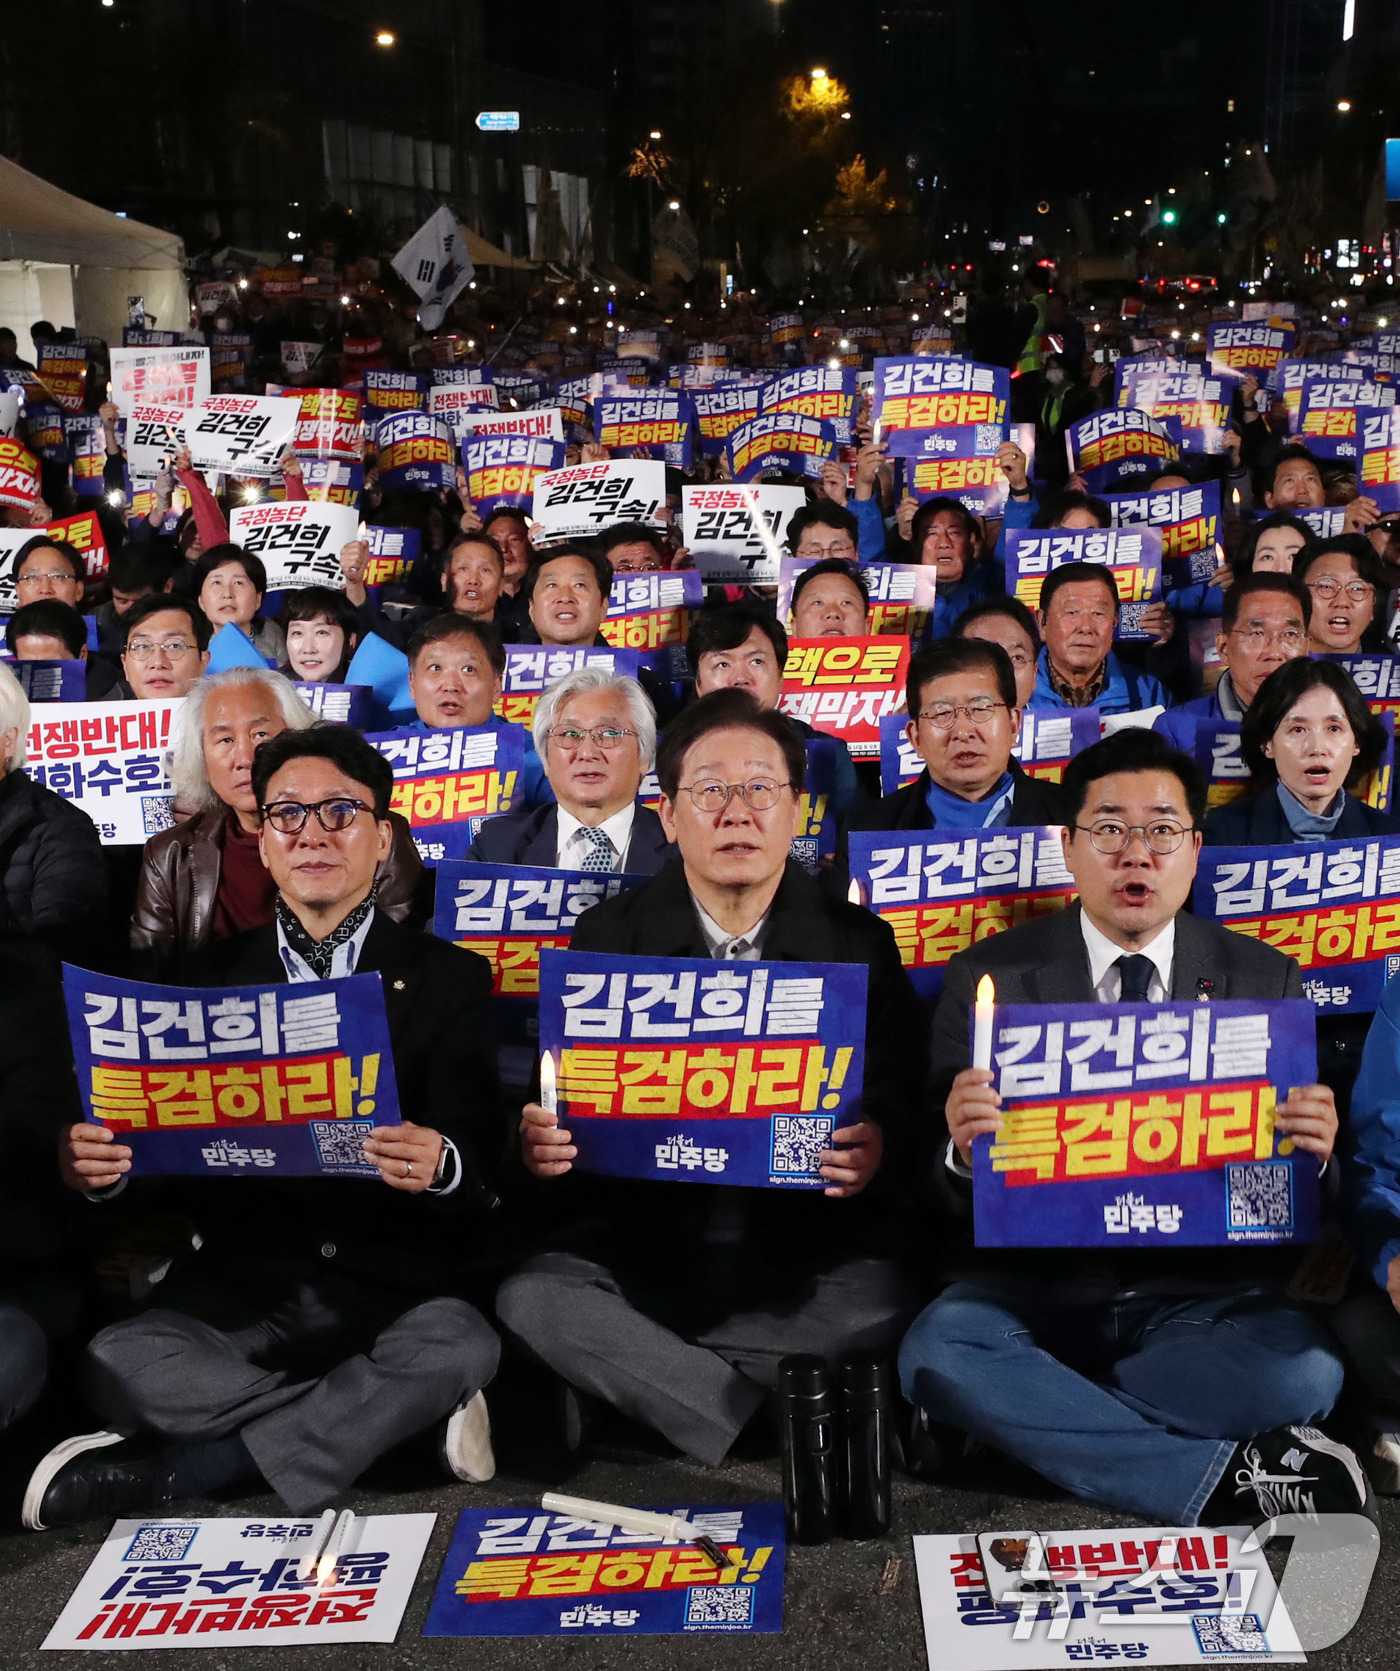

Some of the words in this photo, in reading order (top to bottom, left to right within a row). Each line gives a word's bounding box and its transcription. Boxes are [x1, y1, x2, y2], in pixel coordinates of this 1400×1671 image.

[1213, 327, 1285, 348] 김건희를
[366, 371, 417, 391] 김건희를
[762, 368, 844, 409] 김건희를
[883, 362, 994, 396] 김건희를
[1134, 376, 1222, 404] 김건희를
[200, 397, 258, 414] 국정농단
[286, 393, 360, 419] 핵으로
[366, 389, 424, 409] 특검하라!
[695, 390, 759, 415] 김건희를
[1308, 383, 1396, 408] 김건희를
[131, 406, 184, 425] 국정농단
[196, 412, 272, 438] 김건희
[600, 400, 679, 425] 김건희를
[879, 395, 1007, 429] 특검하라!
[1302, 411, 1356, 436] 특검
[599, 422, 688, 447] 특검하라!
[732, 415, 822, 454] 김건희를
[924, 439, 957, 451] 민주당
[467, 437, 554, 471] 김건희를
[734, 432, 833, 475] 특검하라!
[540, 464, 610, 487] 국정농단
[1118, 463, 1147, 476] 민주당
[545, 477, 634, 508] 김건희
[689, 490, 760, 509] 국정농단
[237, 506, 307, 527] 국정농단
[589, 499, 659, 524] 구속!
[242, 524, 331, 552] 김건희
[694, 510, 783, 540] 김건희
[1016, 531, 1143, 574] 김건희를
[868, 832, 1076, 905] 김건희를
[561, 968, 825, 1038] 김건희를
[83, 991, 342, 1061] 김건희를
[993, 1007, 1272, 1099] 김건희를
[89, 1052, 381, 1128] 특검하라!
[555, 1043, 855, 1114] 특검하라!
[201, 1147, 277, 1167] 민주당
[655, 1143, 729, 1173] 민주당
[1103, 1204, 1184, 1234] 민주당
[240, 1523, 314, 1538] 민주당
[454, 1546, 774, 1598] 특검하라!
[75, 1587, 379, 1641] 전쟁반대!
[559, 1608, 641, 1628] 민주당
[683, 1624, 753, 1632] sign.theminjoo.kr
[1064, 1642, 1150, 1661] 민주당
